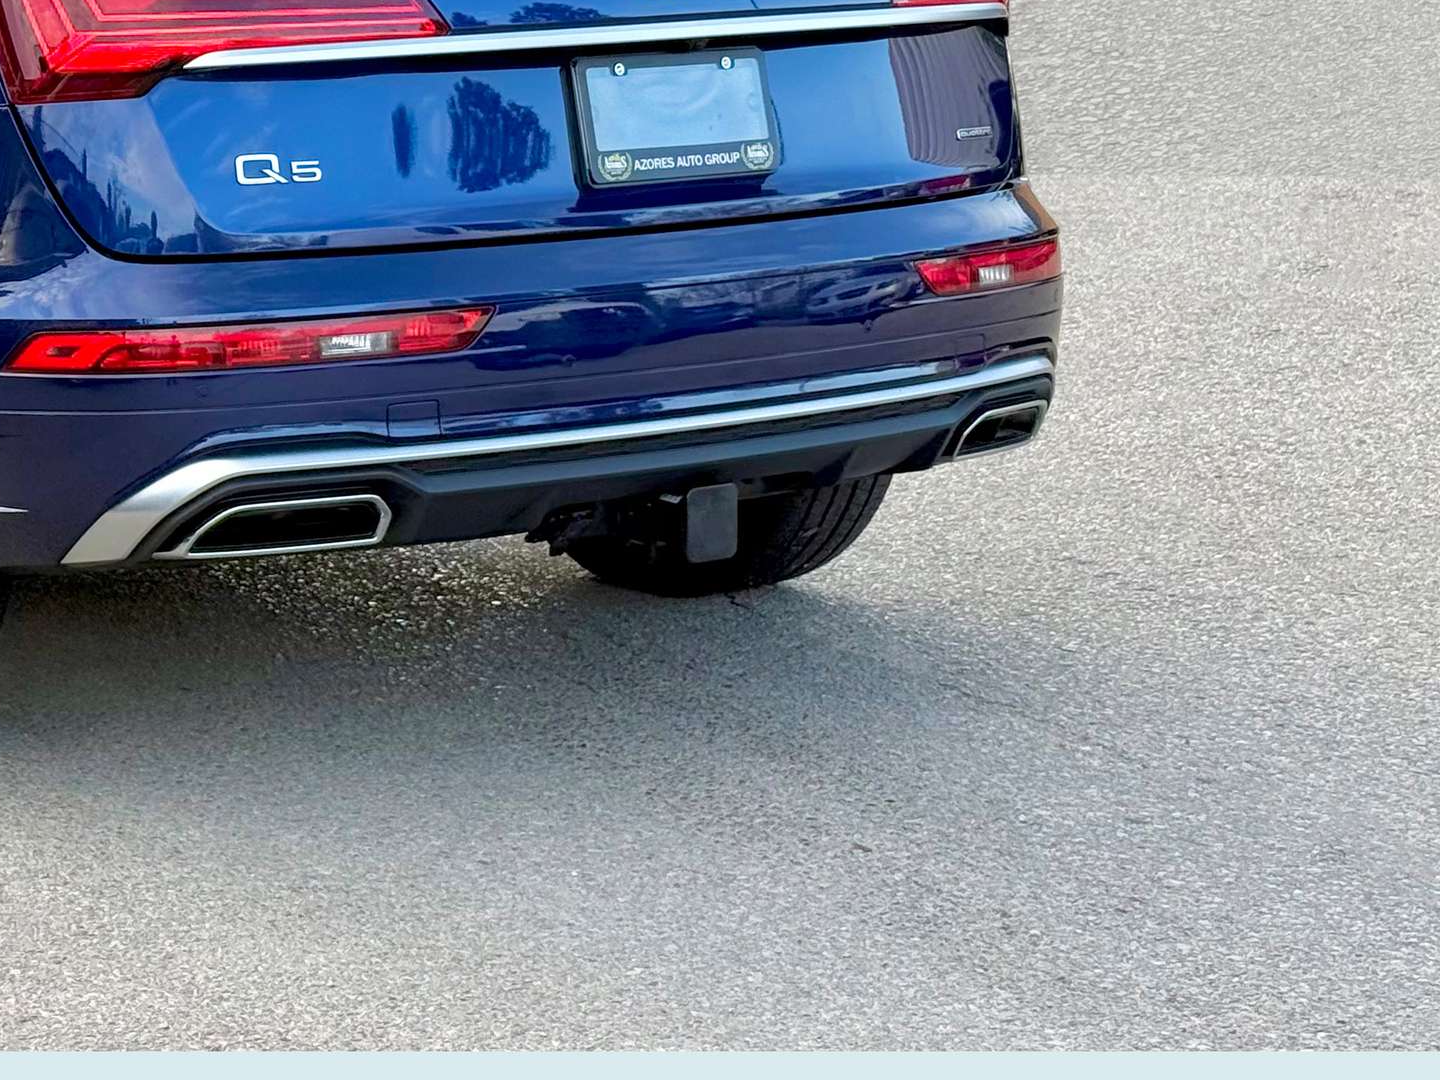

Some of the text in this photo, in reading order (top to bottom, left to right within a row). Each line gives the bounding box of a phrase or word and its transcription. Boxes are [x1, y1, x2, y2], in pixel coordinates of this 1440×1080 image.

[235, 153, 322, 185] Q5
[634, 157, 675, 170] AZORES
[676, 155, 703, 168] AUTO
[704, 152, 740, 165] GROUP
